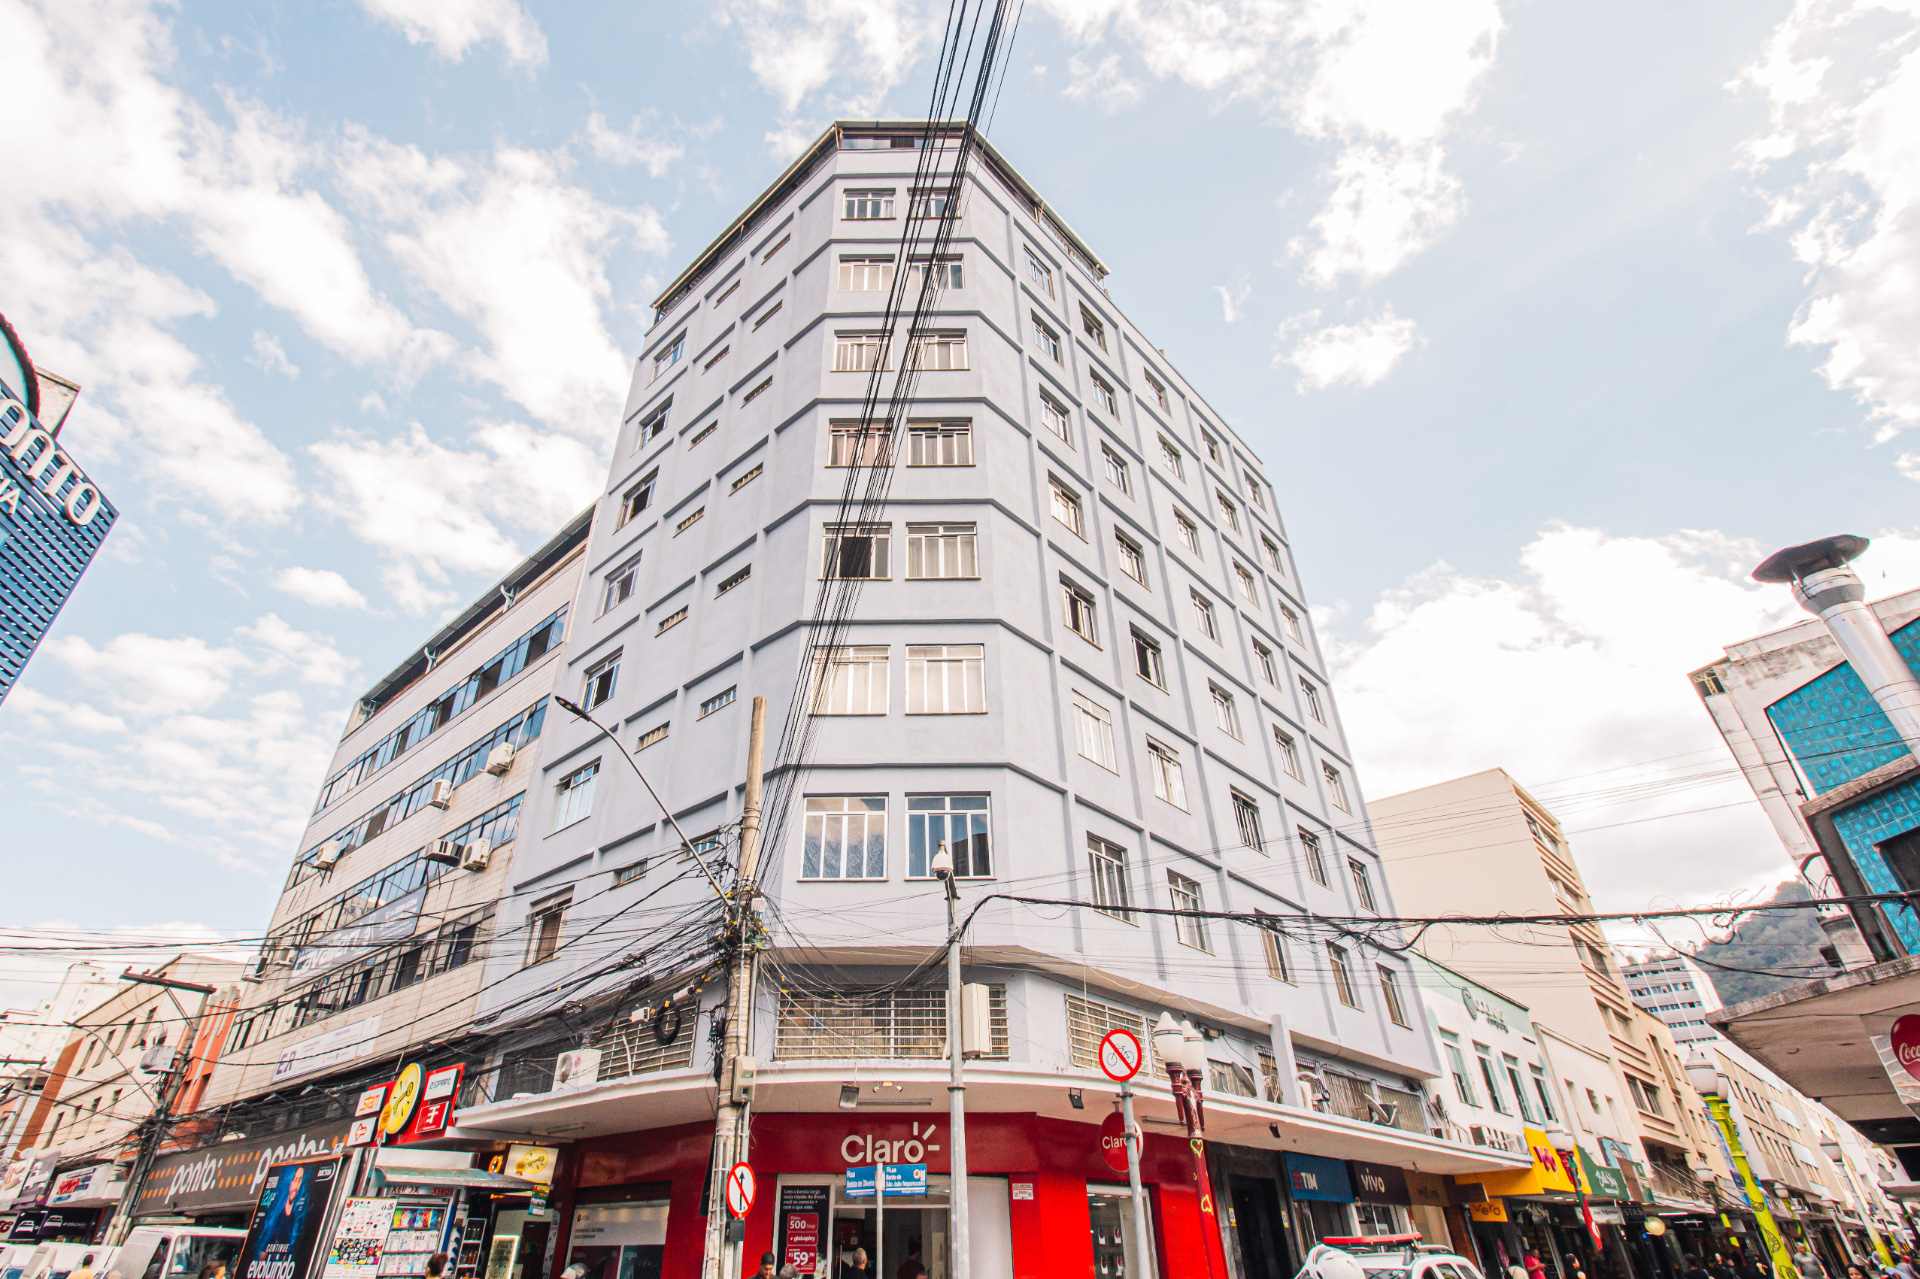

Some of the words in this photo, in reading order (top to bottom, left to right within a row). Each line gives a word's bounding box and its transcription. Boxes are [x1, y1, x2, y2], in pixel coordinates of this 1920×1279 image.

[1898, 1042, 1920, 1065] Coc
[841, 1134, 924, 1163] Claro
[1301, 1172, 1318, 1190] TIM
[1360, 1168, 1386, 1193] vivo
[391, 1185, 420, 1194] XEROX
[432, 1187, 454, 1196] XEROX
[790, 1220, 806, 1229] 500
[265, 1243, 290, 1253] CONTINUE
[246, 1253, 296, 1279] evoluindo
[793, 1251, 809, 1266] 59
